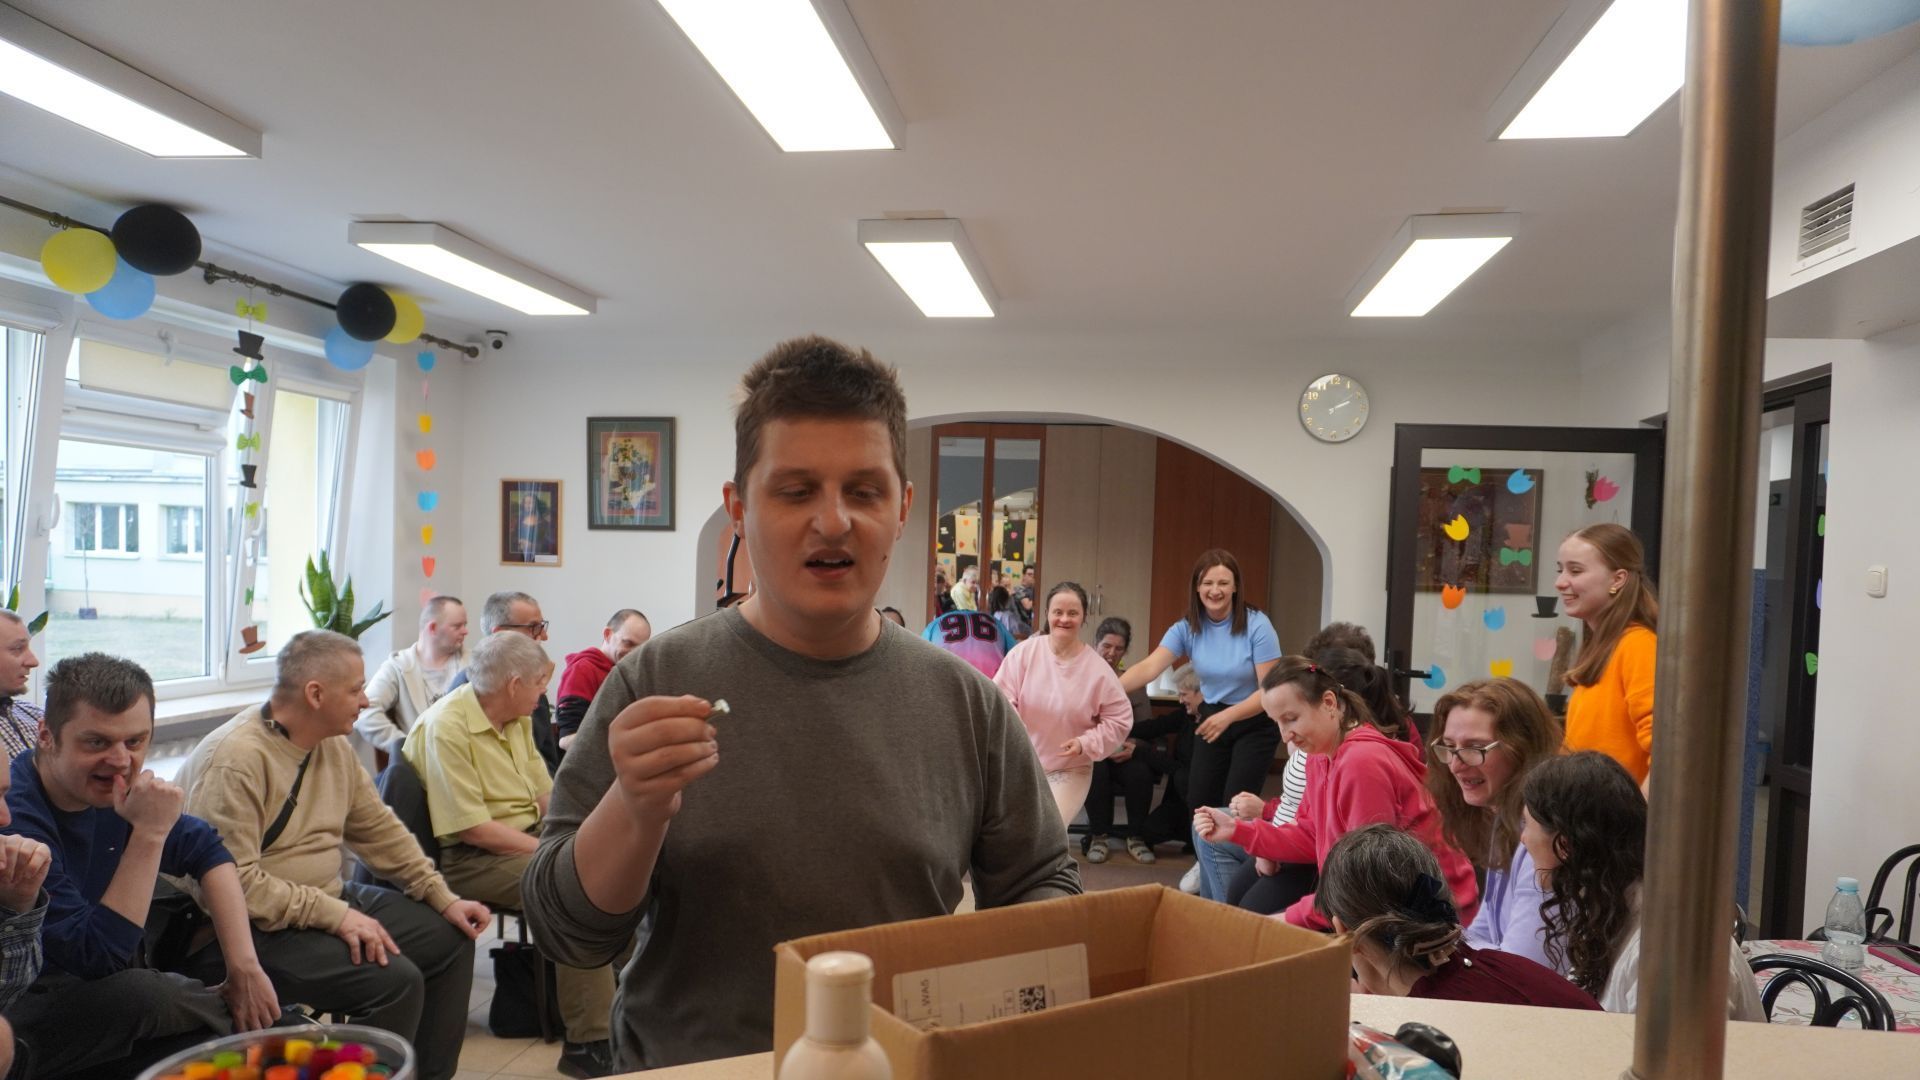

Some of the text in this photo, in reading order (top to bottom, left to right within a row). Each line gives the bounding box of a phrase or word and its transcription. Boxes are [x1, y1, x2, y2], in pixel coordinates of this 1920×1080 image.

[1330, 376, 1341, 385] 12
[1317, 382, 1327, 391] 11
[1307, 391, 1319, 400] 10
[940, 613, 998, 643] 96
